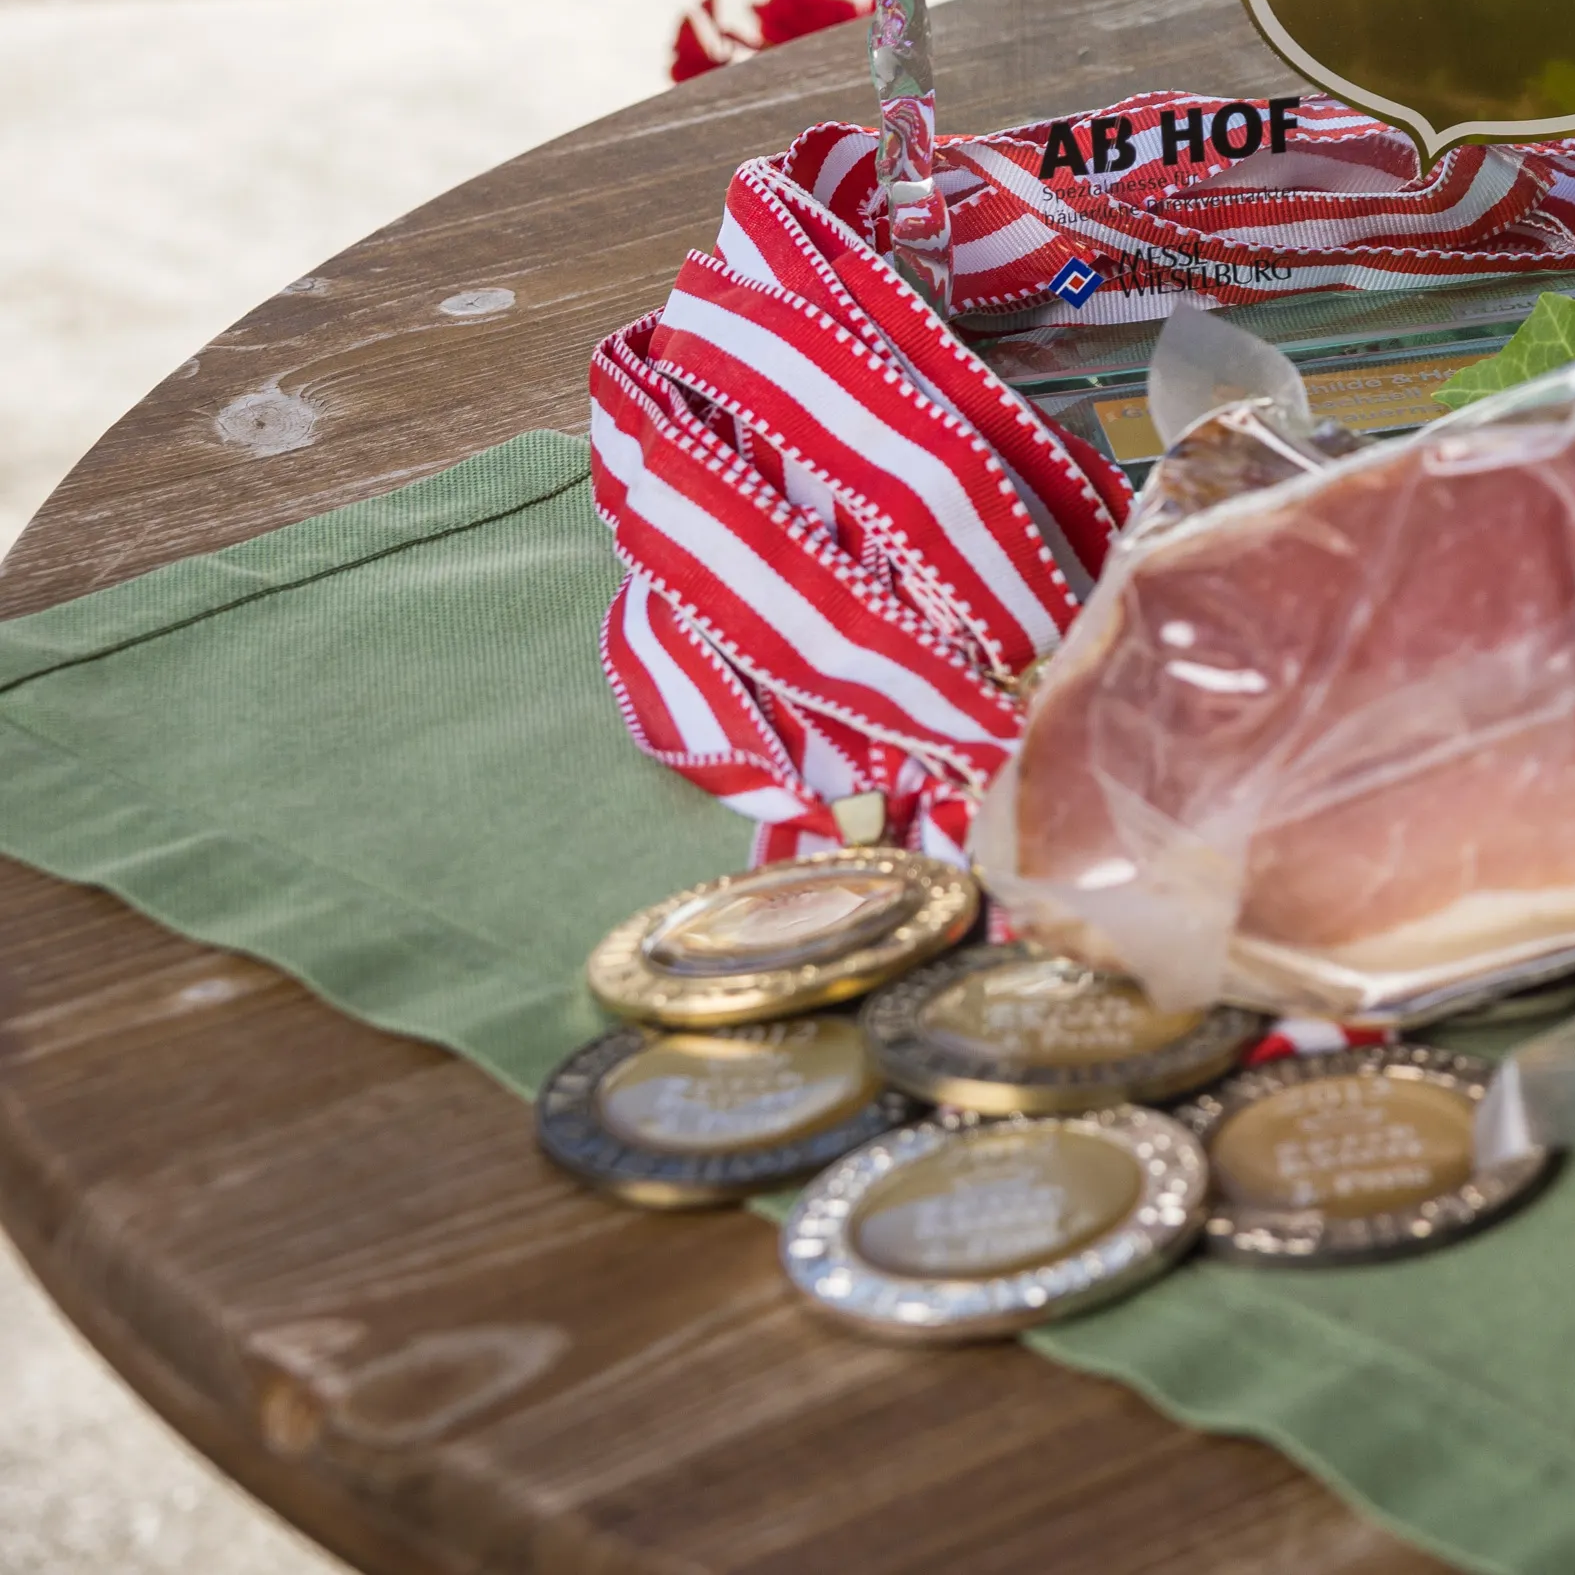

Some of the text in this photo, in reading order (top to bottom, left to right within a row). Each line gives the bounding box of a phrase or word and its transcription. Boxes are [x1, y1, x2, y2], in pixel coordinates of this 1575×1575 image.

[1038, 95, 1302, 181] AB HOF
[1042, 170, 1202, 207] Spezialmesse für
[1043, 185, 1301, 226] bäuerliche Direktvermarkter
[1118, 240, 1209, 274] MESSE
[1116, 256, 1293, 300] WIESELBURG
